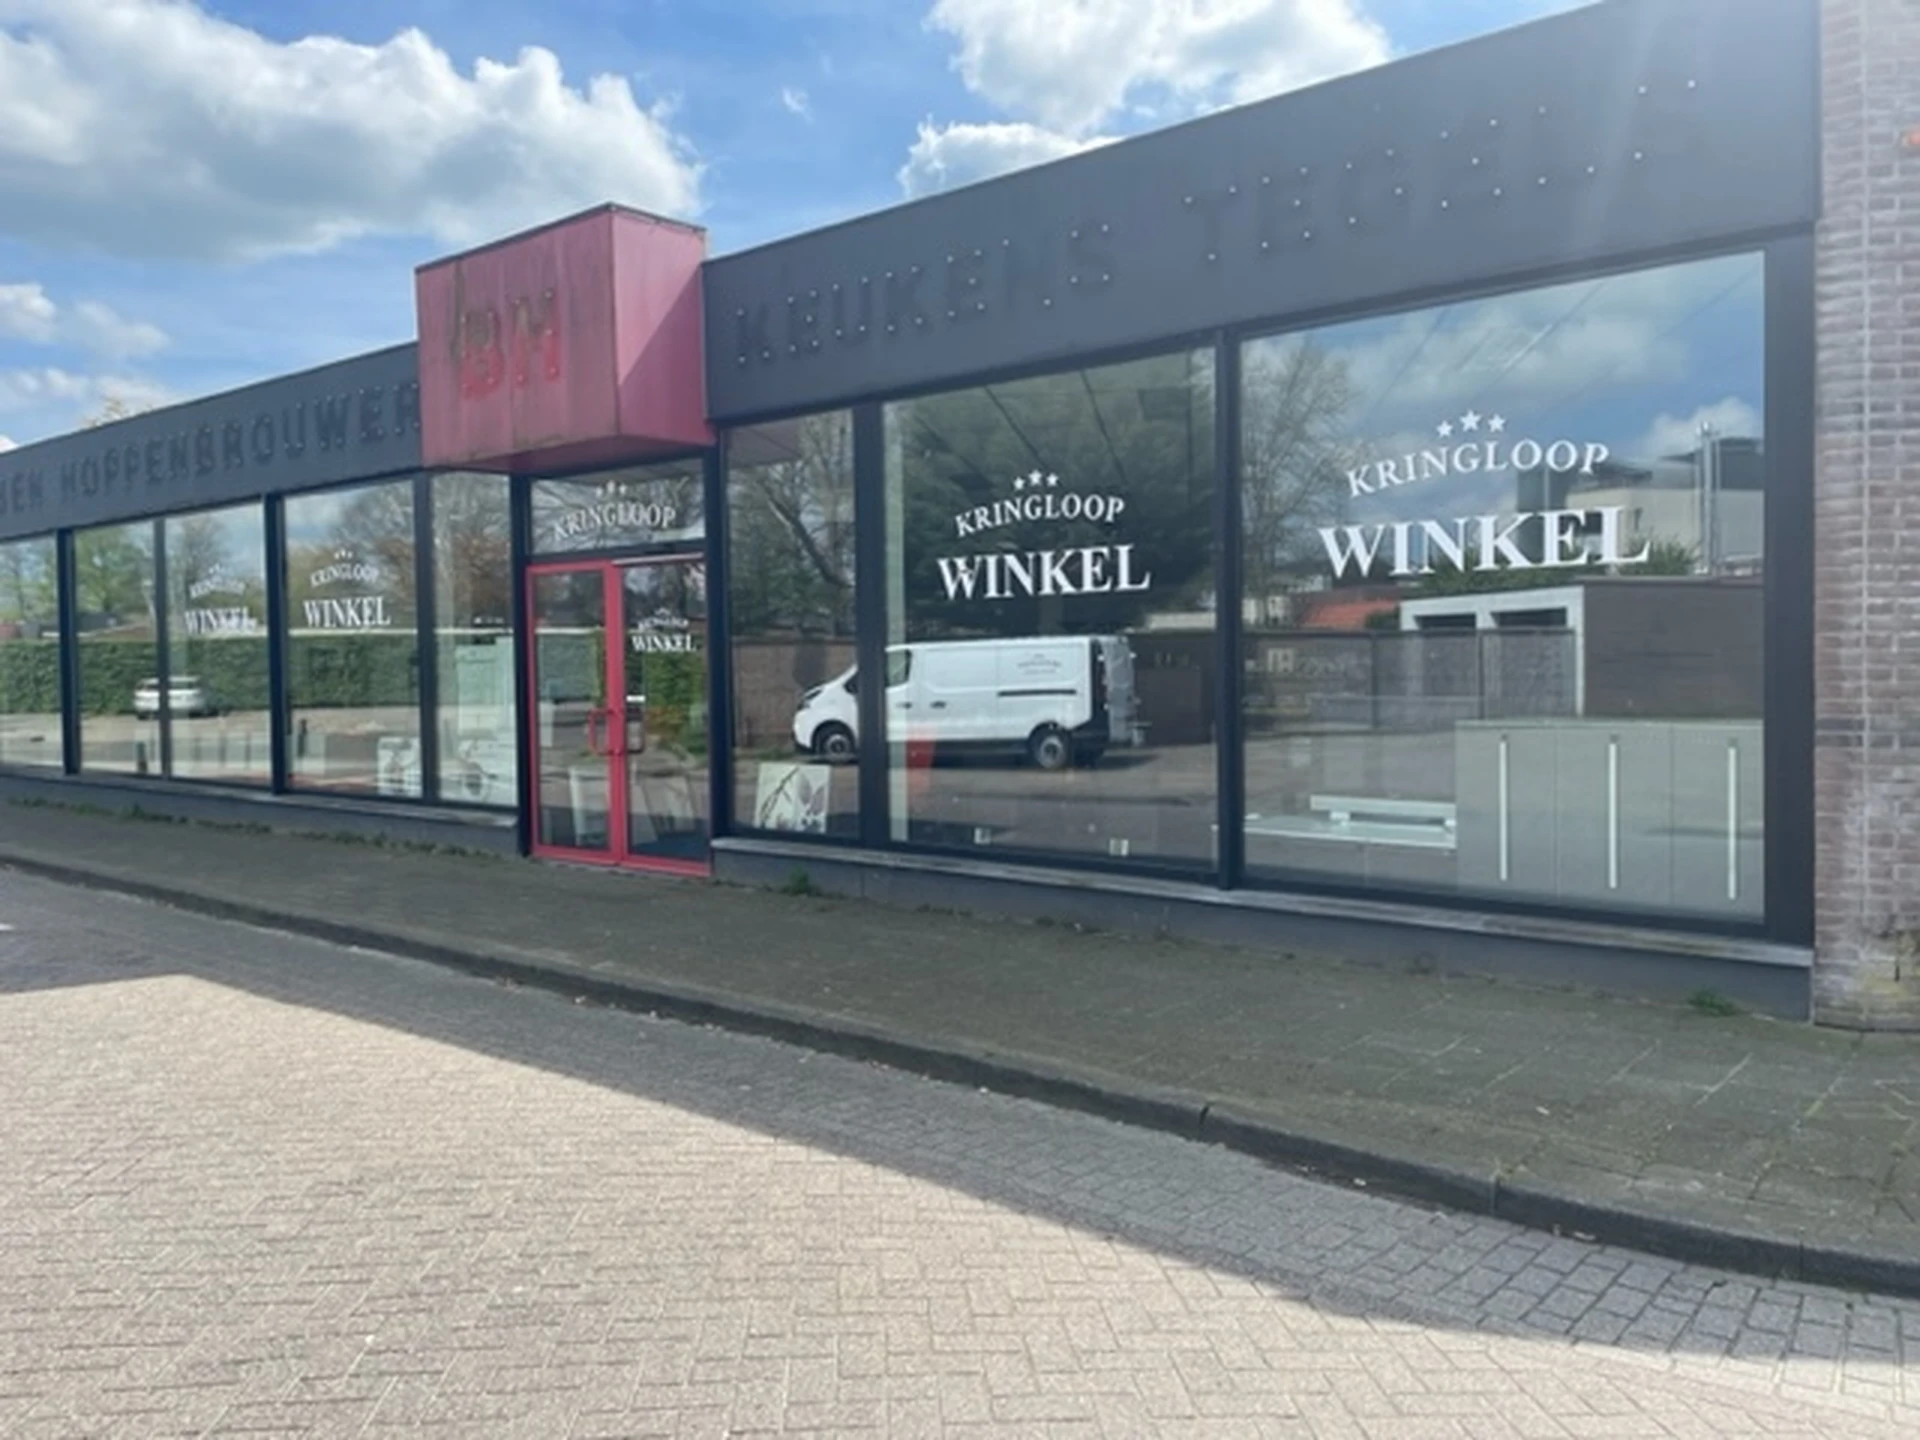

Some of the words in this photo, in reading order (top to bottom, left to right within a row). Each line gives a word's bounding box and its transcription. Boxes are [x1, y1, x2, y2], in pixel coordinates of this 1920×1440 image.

[734, 219, 1119, 366] KEUKENS
[1347, 438, 1609, 497] KRINGLOOP
[552, 501, 676, 541] KRINGLOOP
[954, 492, 1125, 537] KRINGLOOP
[1318, 505, 1651, 579] WINKEL
[937, 543, 1150, 600] WINKEL
[184, 606, 257, 635] WINKEL
[303, 596, 391, 629] WINKEL
[631, 633, 697, 653] WINKEL
